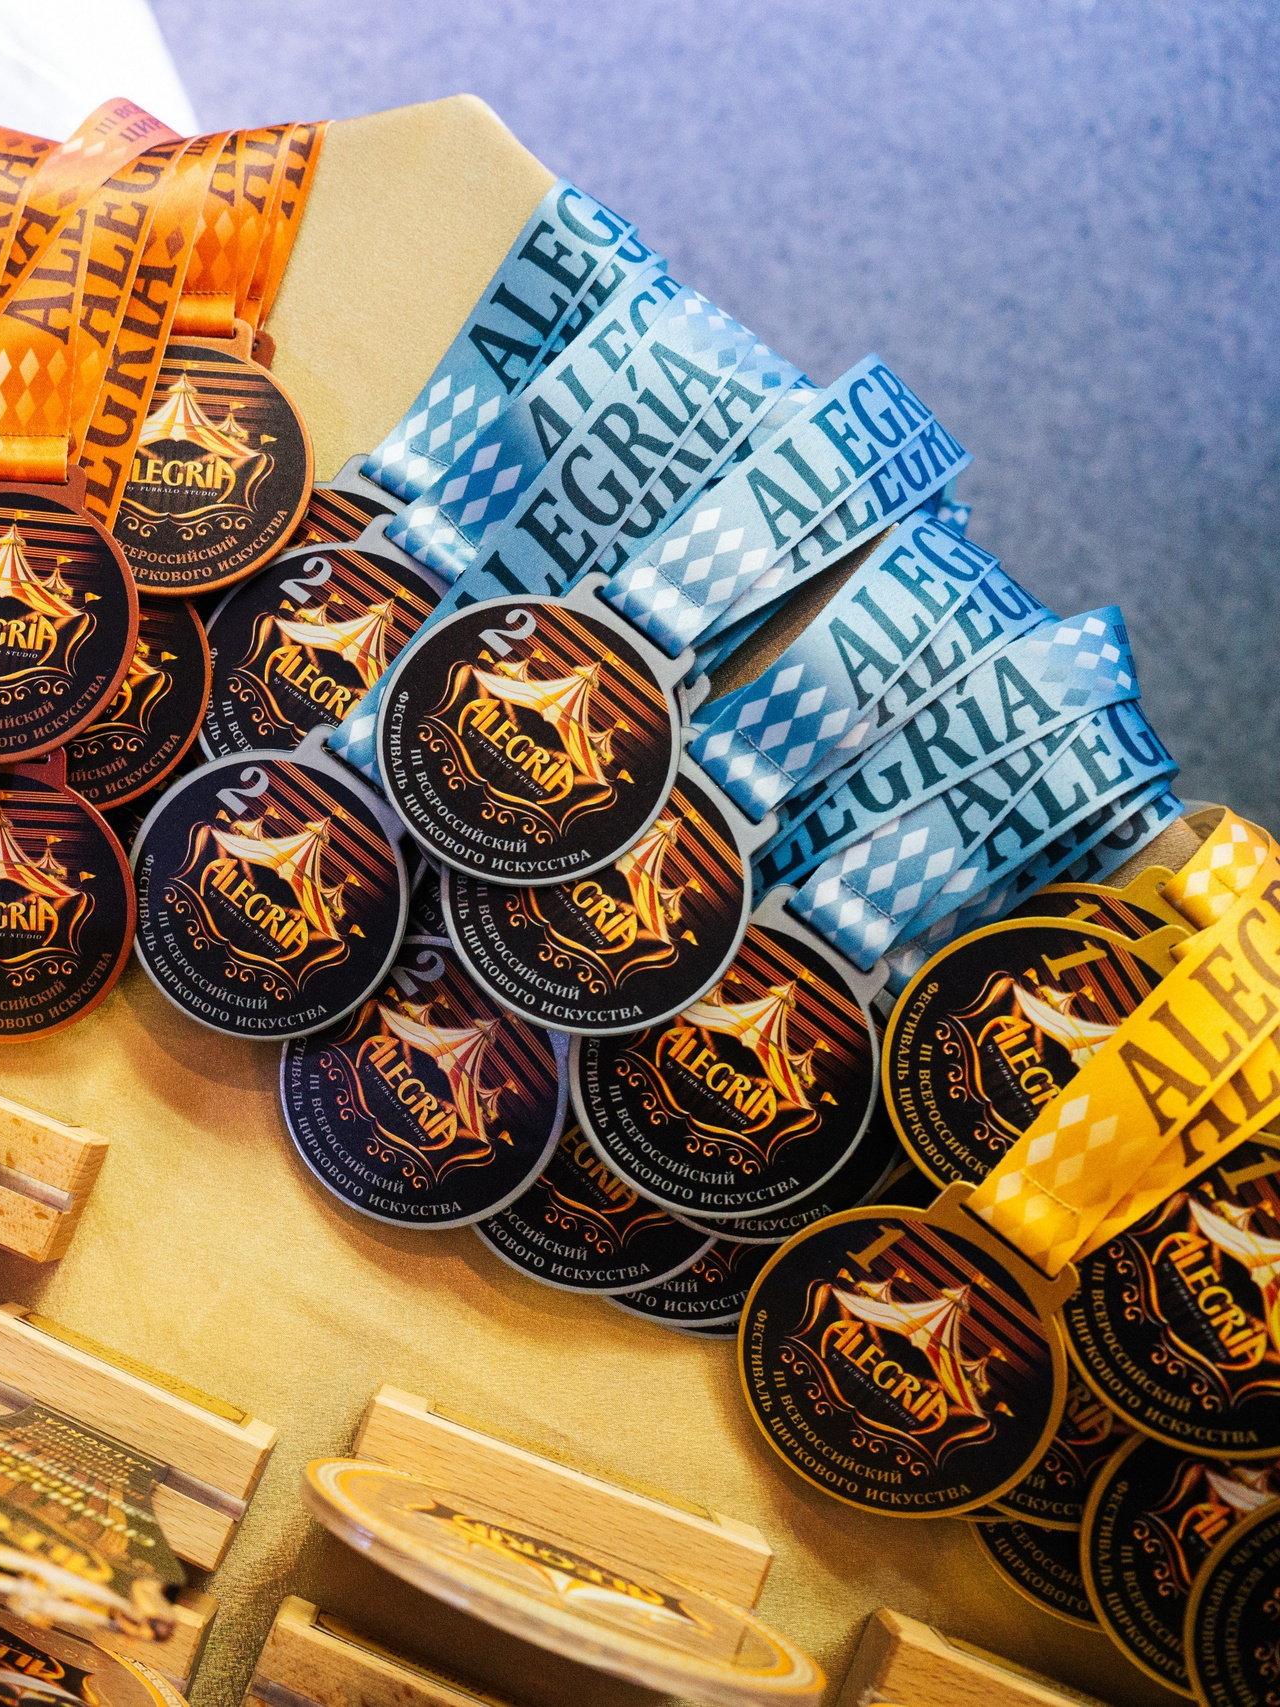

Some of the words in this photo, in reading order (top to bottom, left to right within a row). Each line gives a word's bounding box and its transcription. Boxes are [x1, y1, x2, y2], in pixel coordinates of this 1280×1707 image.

[468, 187, 623, 395] ALEG
[480, 341, 722, 599] LEGRÍA
[746, 364, 931, 550] ALEGR
[184, 489, 218, 498] STUDIO
[217, 509, 288, 572] ИСКУССТВА
[279, 556, 333, 604] 2
[479, 608, 537, 656] 2
[828, 520, 988, 710] ALEG
[5, 650, 38, 660] STUDIO
[34, 673, 107, 740] ИСКУССТВА
[222, 700, 234, 717] III
[106, 732, 181, 795] ИСКУССТВА
[215, 766, 270, 815] 2
[389, 690, 410, 790] ФЕСТИВАЛЬ
[404, 793, 485, 865] ЦИРКОВОГО
[491, 848, 591, 872] ИСКУССТВА
[514, 770, 545, 797] STUDIO
[410, 748, 423, 766] III
[417, 769, 527, 853] ВСЕРОССИЙСКИЙ
[10, 932, 42, 940] STUDIO
[140, 854, 156, 951] ФЕСТИВАЛЬ
[153, 956, 230, 1022] ЦИРКОВОГО
[236, 1004, 328, 1029] ИСКУССТВА
[158, 910, 168, 923] III
[163, 927, 268, 1010] ВСЕРОССИЙСКИЙ
[253, 928, 282, 955] STUDIO
[477, 903, 580, 1001] ВСЕРОССИЙСКИЙ
[578, 915, 605, 945] STUDIO
[1040, 940, 1108, 981] 1
[49, 951, 113, 1018] ИСКУССТВА
[391, 949, 446, 997] 2
[463, 924, 536, 1006] ЦИРКОВОГО
[541, 1004, 643, 1022] ИСКУССТВА
[898, 981, 939, 1081] ФЕСТИВАЛЬ
[920, 1043, 933, 1062] III
[309, 1072, 320, 1092] III
[715, 1100, 748, 1126] STUDIO
[311, 1097, 405, 1195] ВСЕРОССИЙСКИЙ
[402, 1111, 427, 1142] STUDIO
[586, 1037, 608, 1130] ЕСТИВАЛЬ
[606, 1133, 694, 1200] ЦИРКОВОГО
[700, 1175, 801, 1205] ИСКУССТВА
[609, 1084, 621, 1103] III
[616, 1106, 735, 1185] ВСЕРОССИЙСКИЙ
[899, 1087, 963, 1182] ЦИРКОВОГО
[298, 1116, 364, 1198] ЦИРКОВОГО
[369, 1194, 462, 1216] ИСКУССТВА
[502, 1205, 588, 1261] ОССИЙСКИЙ
[734, 1203, 833, 1231] ИСКУССТВА
[845, 1224, 906, 1272] 1
[551, 1262, 651, 1281] ИСКУССТВА
[664, 1289, 749, 1313] ИСКУССТВ
[1092, 1261, 1106, 1281] III
[1071, 1308, 1142, 1409] ЦИРКОВОГО
[1145, 1407, 1259, 1444] ИСКУССТВА
[1092, 1288, 1192, 1414] ВСЕРОССИЙСКИЙ
[751, 1308, 774, 1412] ФЕСТИВАЛЬ
[770, 1417, 858, 1493] ЦИРКОВОГО
[865, 1483, 971, 1505] ИСКУССТВА
[773, 1370, 787, 1389] III
[780, 1394, 903, 1484] ВСЕРОССИЙСКИЙ
[1098, 1480, 1129, 1587] ФЕСТИВАЛЬ
[1106, 1592, 1187, 1679] ЦИРКОВОГО
